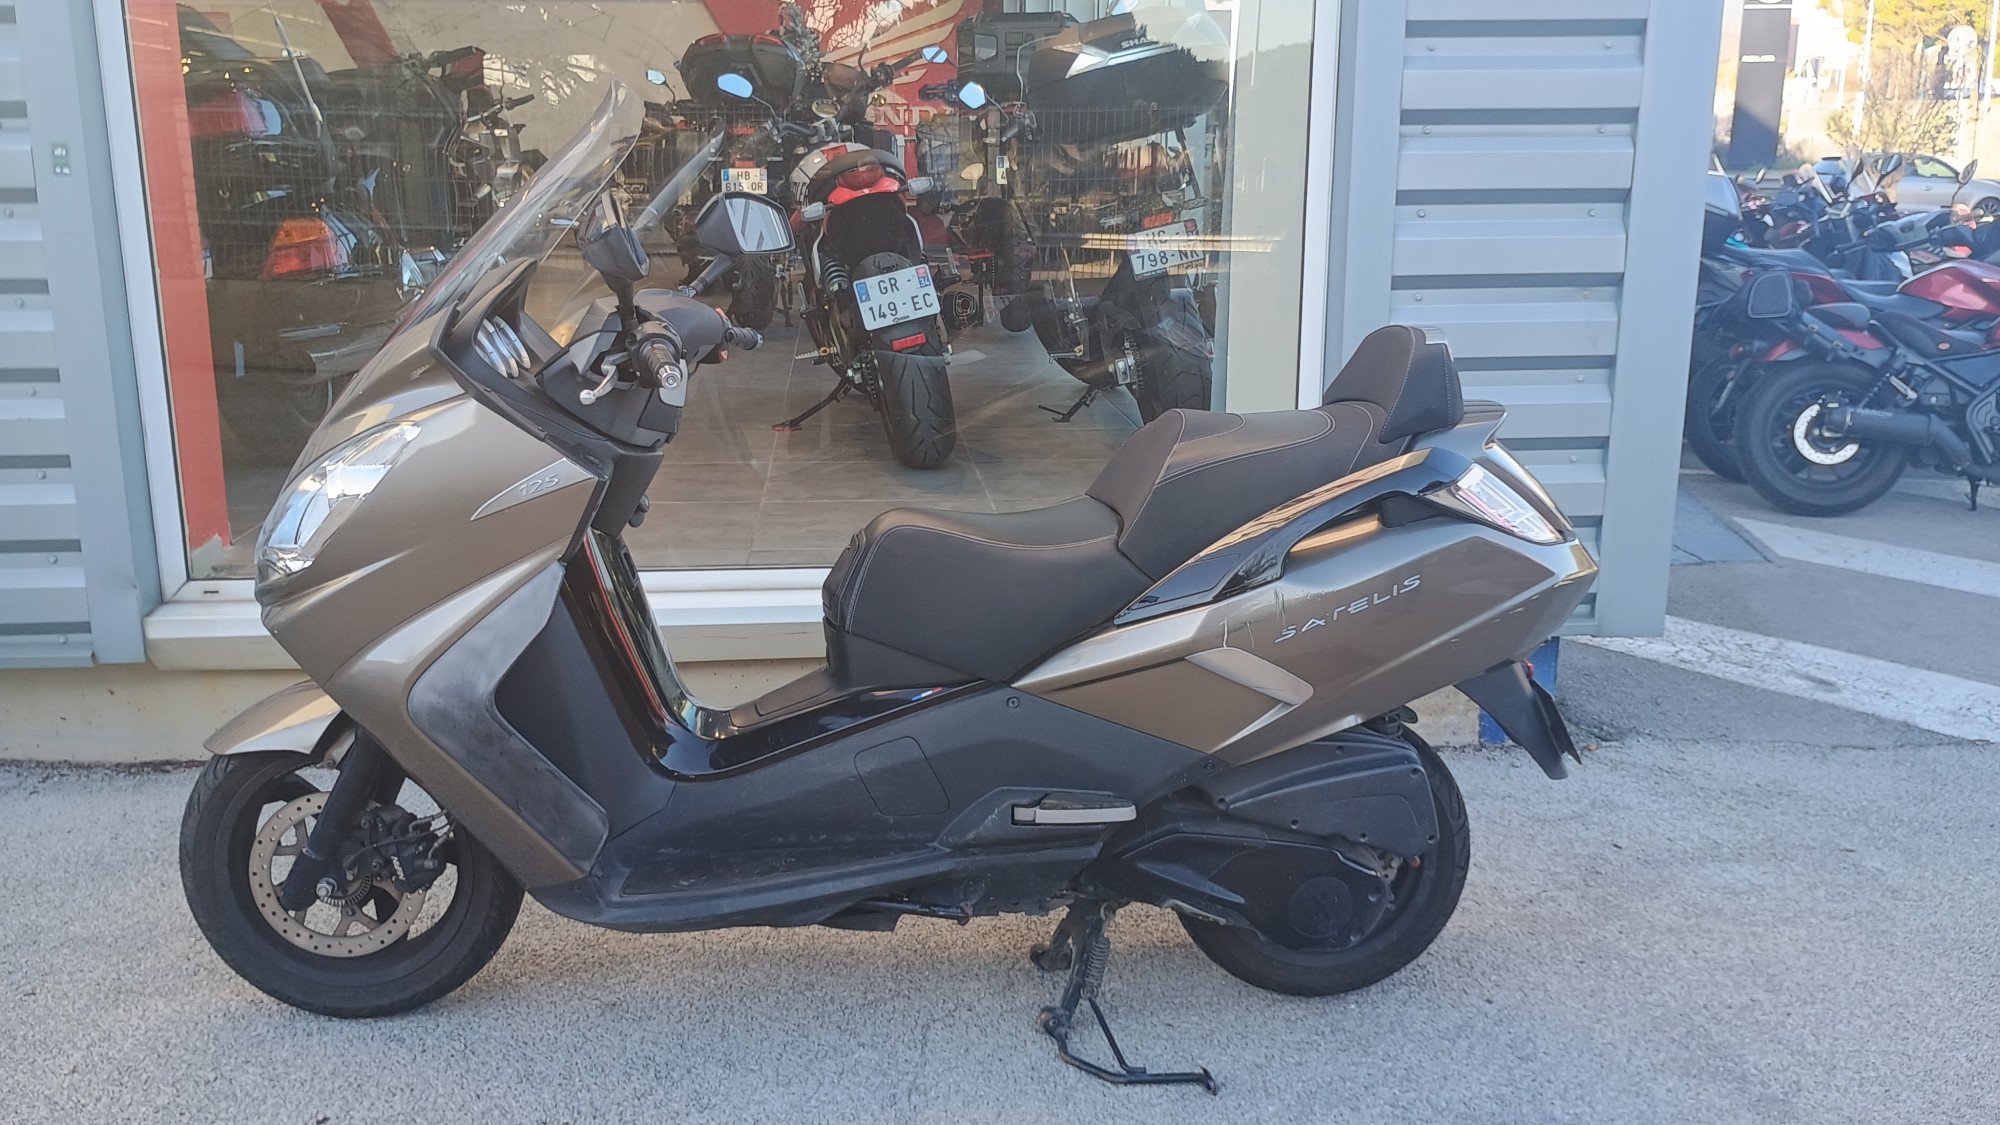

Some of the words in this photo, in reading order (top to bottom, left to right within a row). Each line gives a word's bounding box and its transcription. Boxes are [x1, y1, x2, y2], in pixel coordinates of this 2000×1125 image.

[868, 293, 933, 322] 149-EC
[519, 474, 559, 497] 125
[1275, 574, 1421, 643] SATELIS
